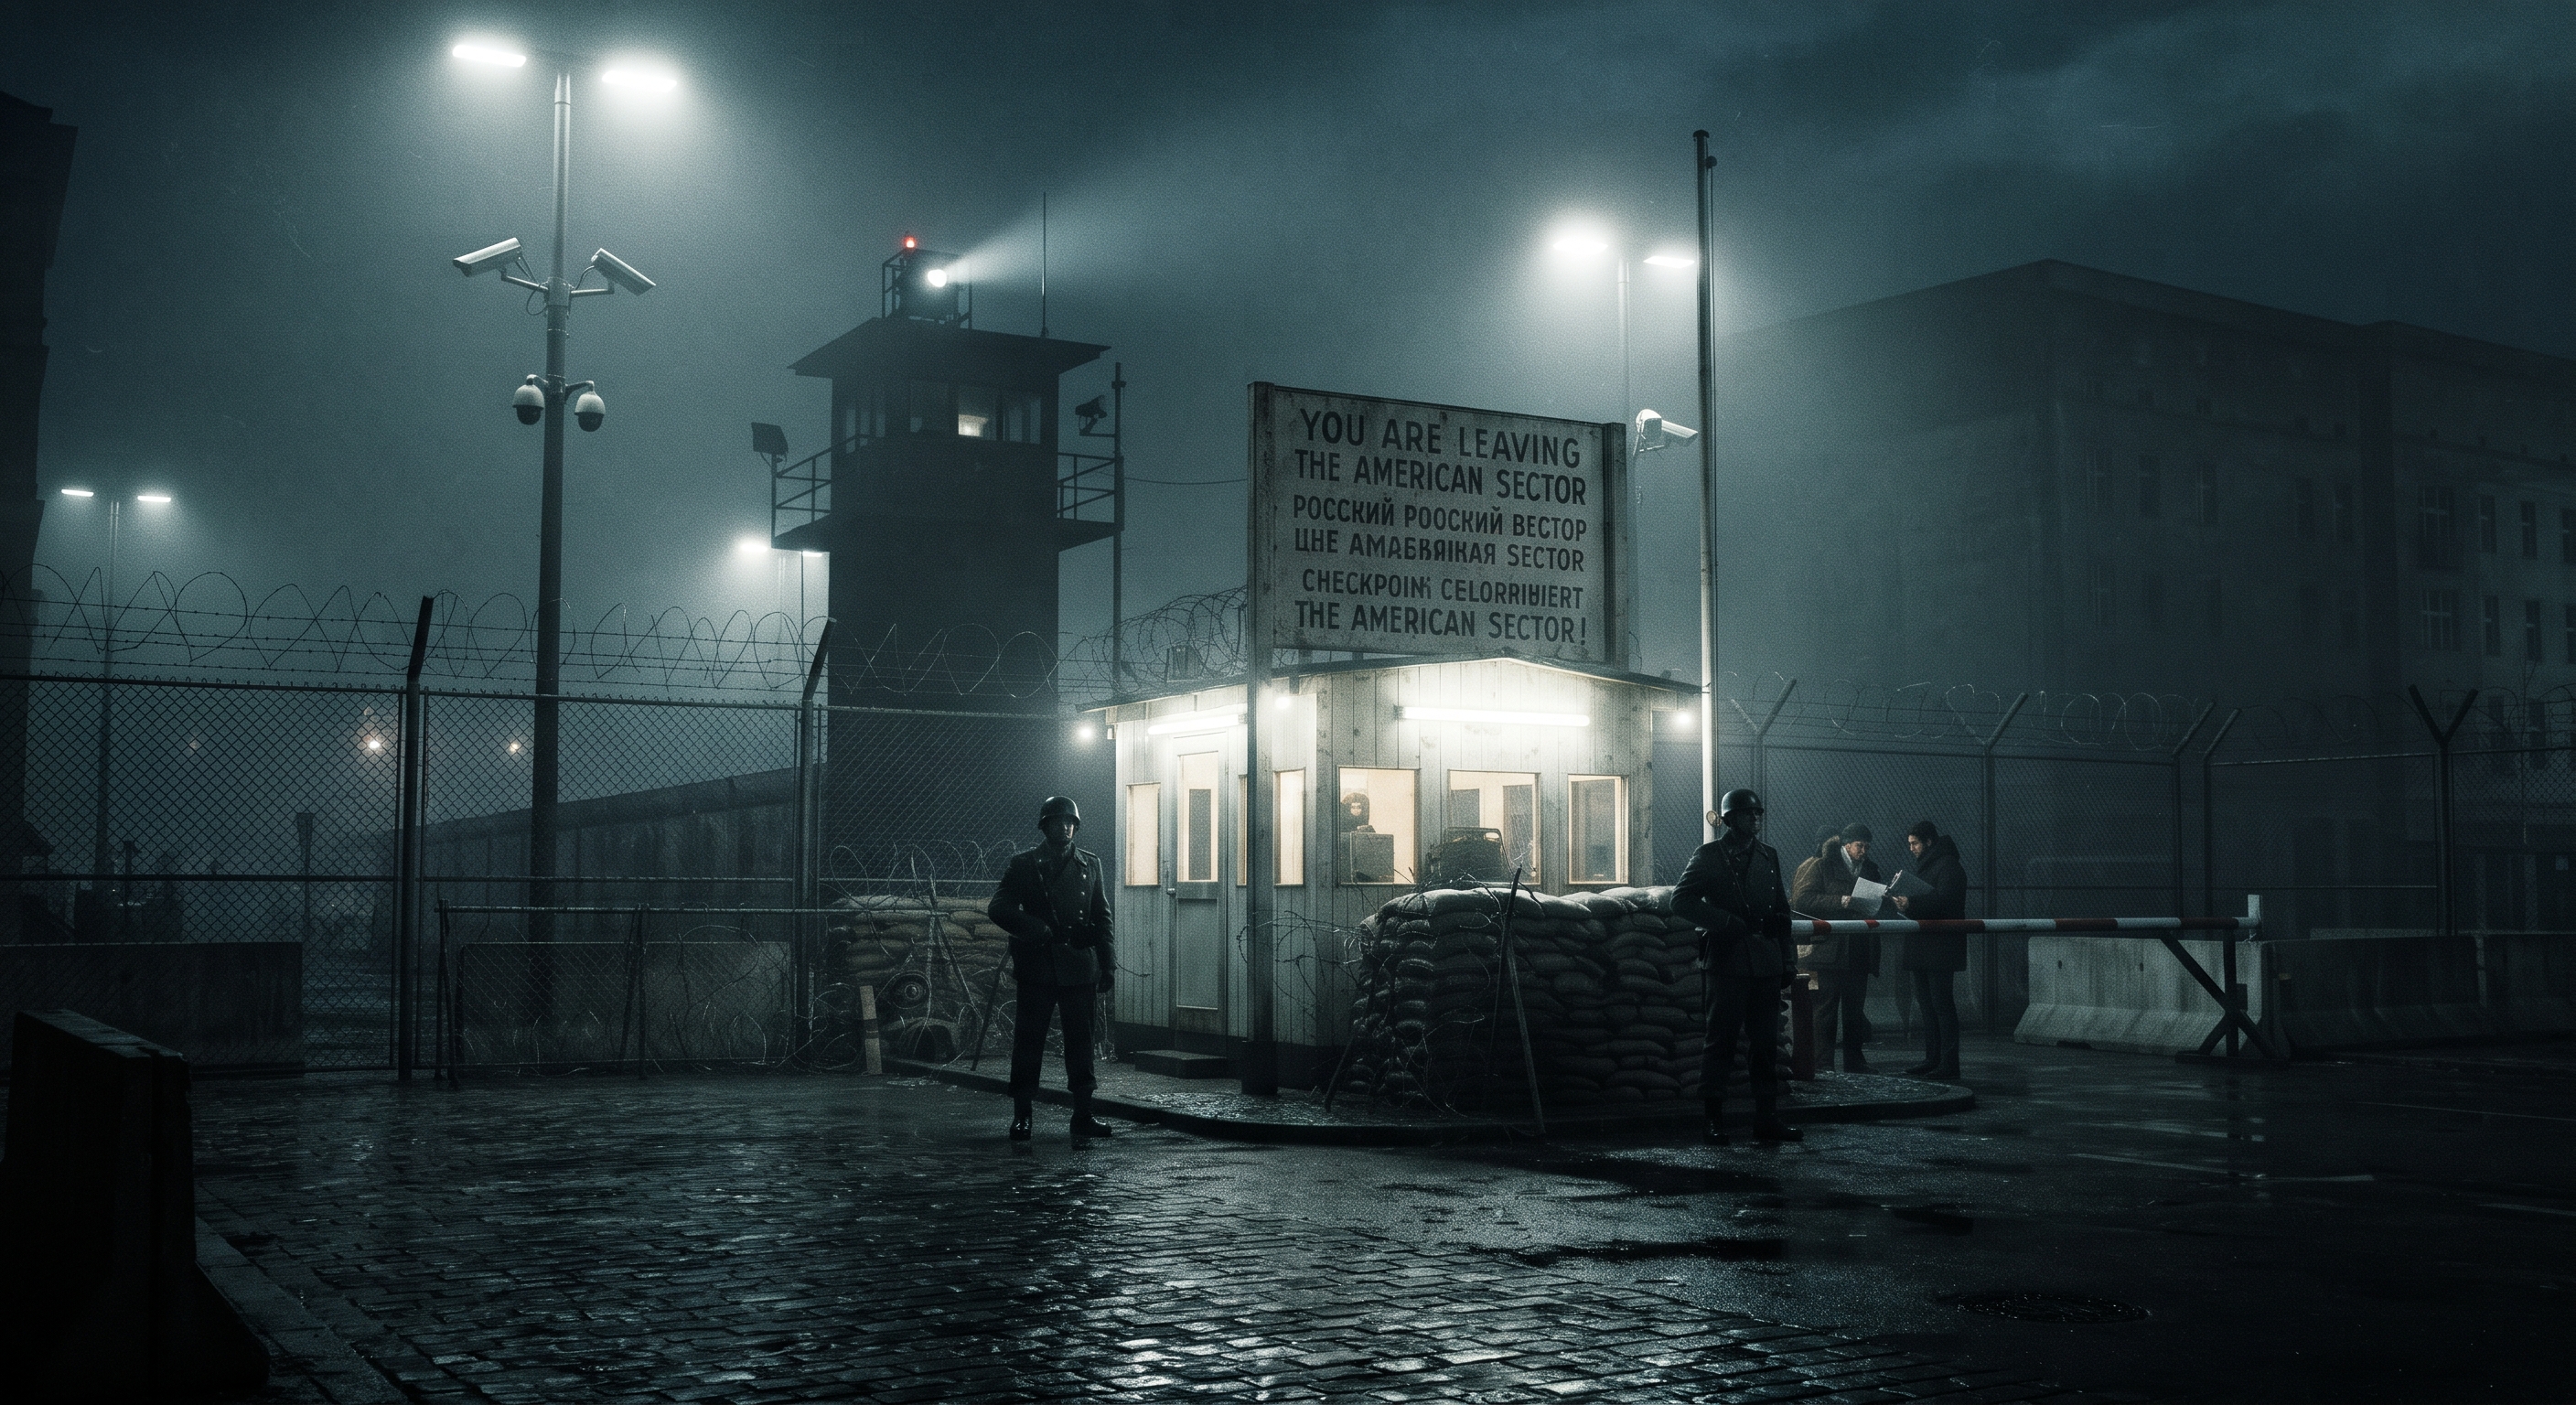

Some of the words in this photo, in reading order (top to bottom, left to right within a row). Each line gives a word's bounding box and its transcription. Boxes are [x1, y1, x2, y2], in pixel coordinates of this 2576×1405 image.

[1300, 408, 1364, 445] YOU
[1382, 419, 1441, 454] ARE
[1459, 426, 1580, 468] LEAVING
[1295, 449, 1340, 481] THE
[1354, 456, 1483, 495] AMERICAN
[1497, 469, 1586, 505] SECTOR
[1508, 543, 1584, 572] SECTOR
[1295, 600, 1340, 629] THE
[1351, 605, 1475, 637] AMERICAN
